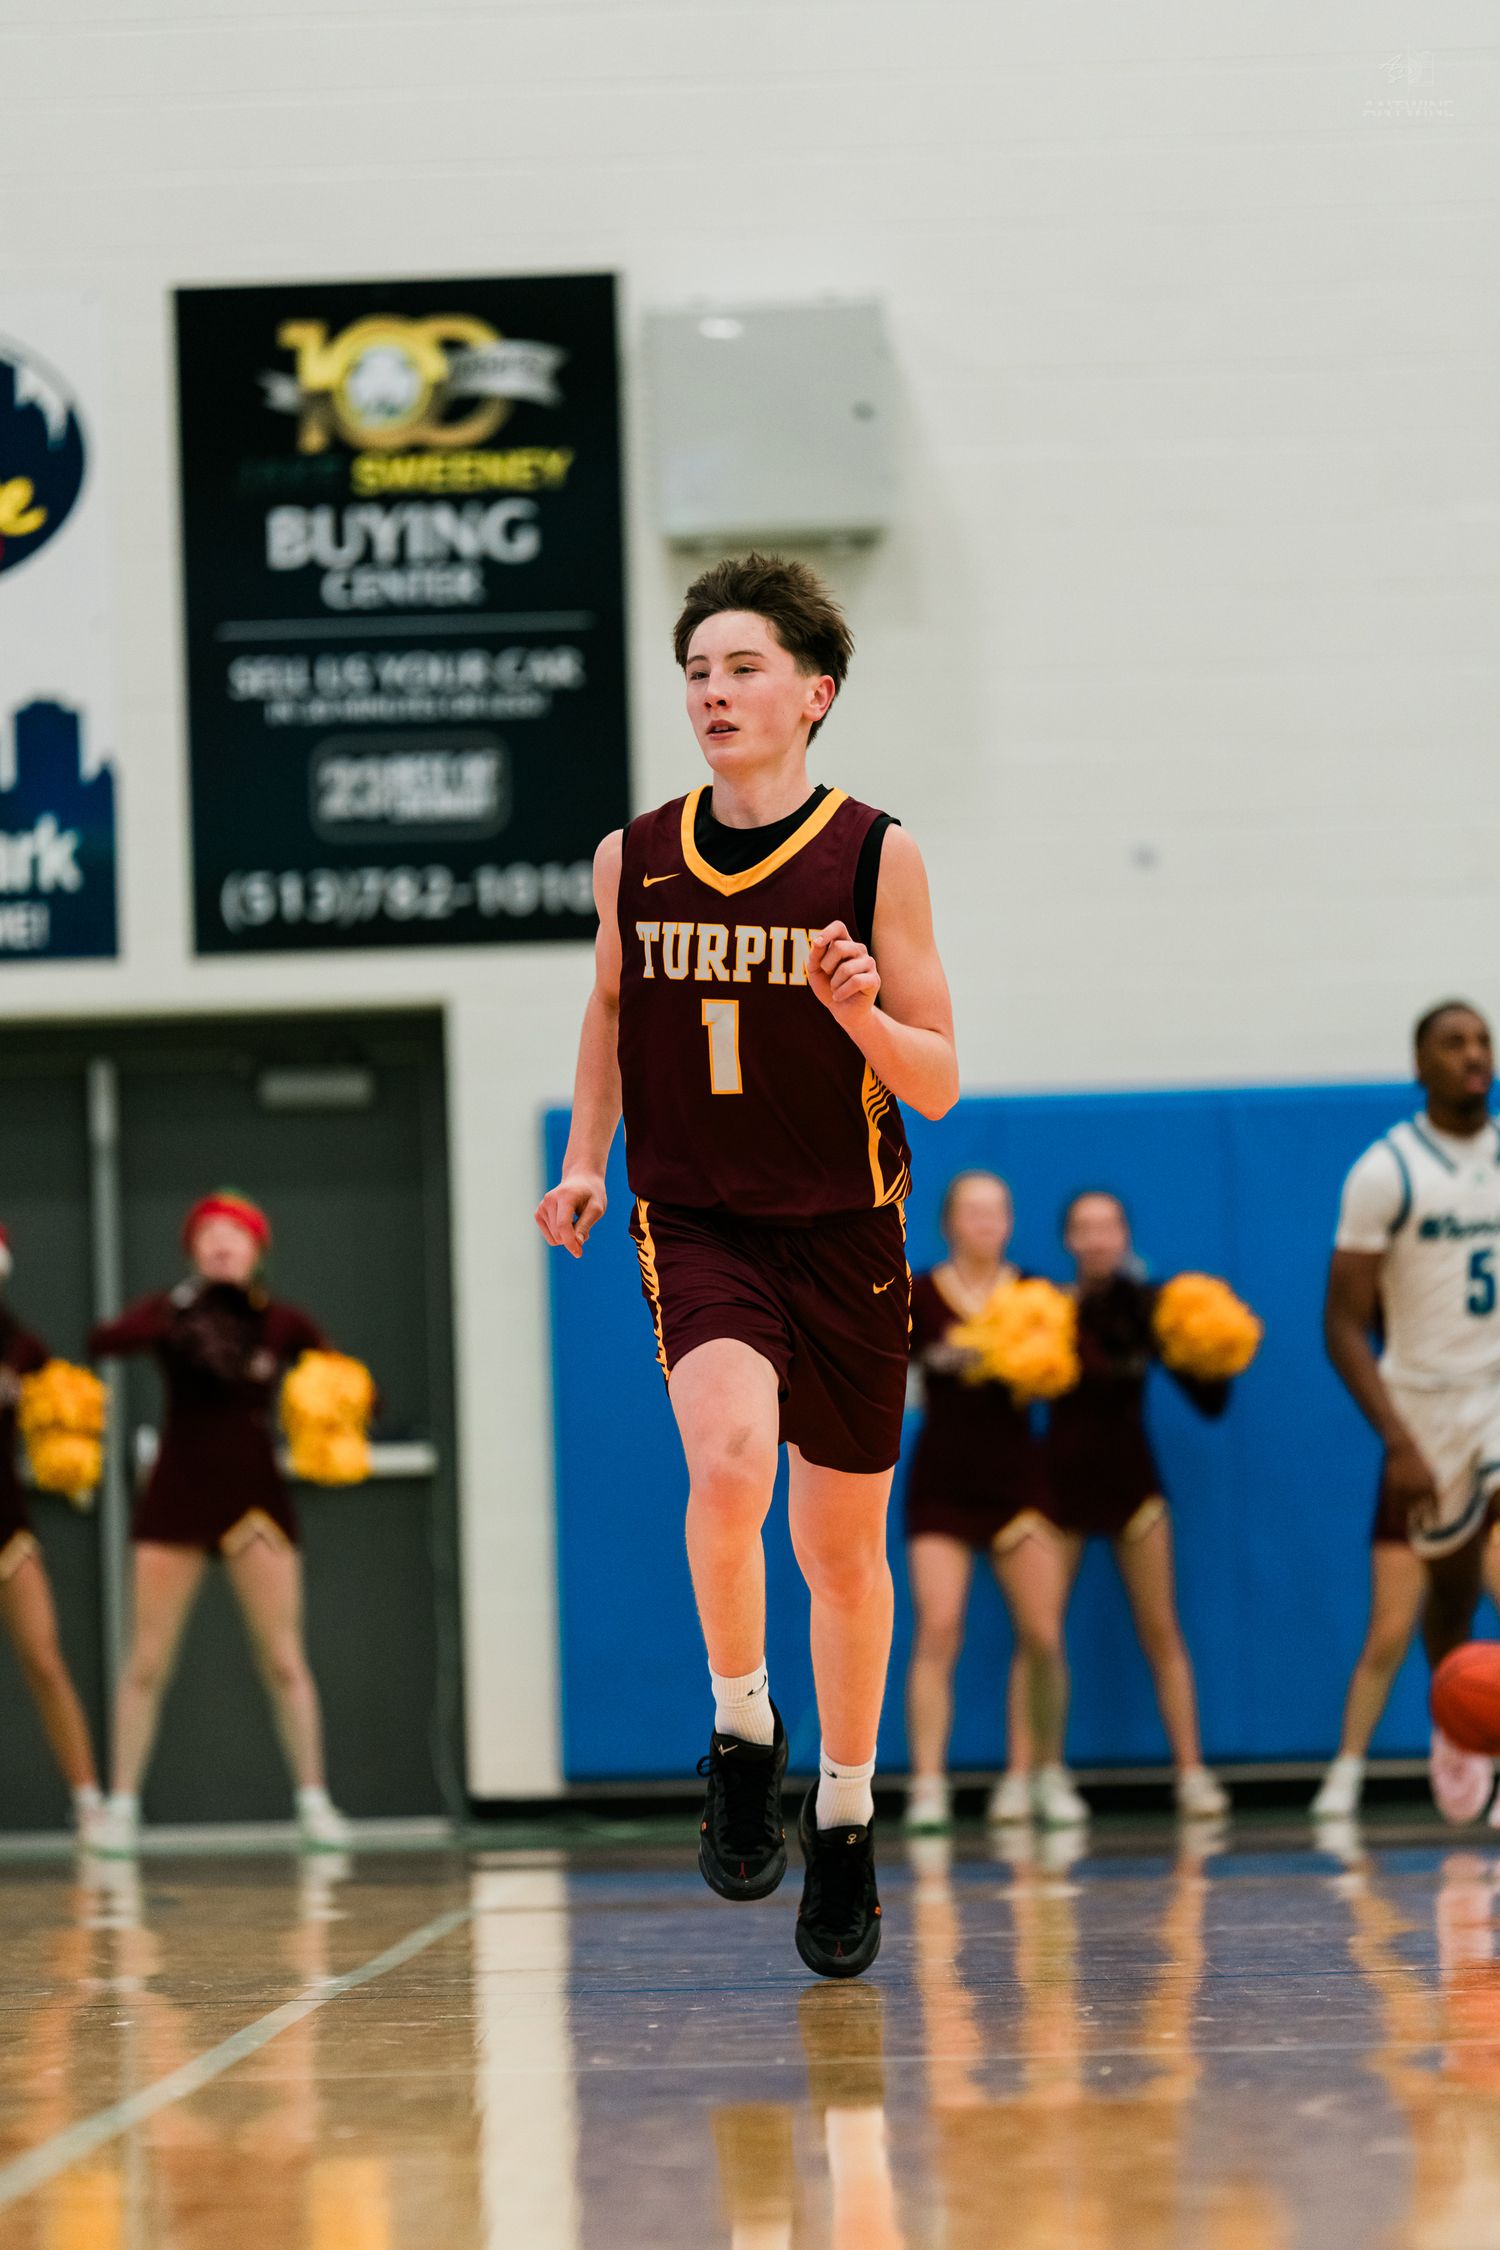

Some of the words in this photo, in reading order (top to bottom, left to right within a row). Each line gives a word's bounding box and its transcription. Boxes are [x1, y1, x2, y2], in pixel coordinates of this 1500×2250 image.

[351, 447, 574, 495] SWEENEY
[266, 499, 541, 570] BUYING
[320, 561, 486, 609] CENTER
[492, 645, 586, 691] CAR
[701, 998, 744, 1095] 1
[1467, 1249, 1496, 1316] 5
